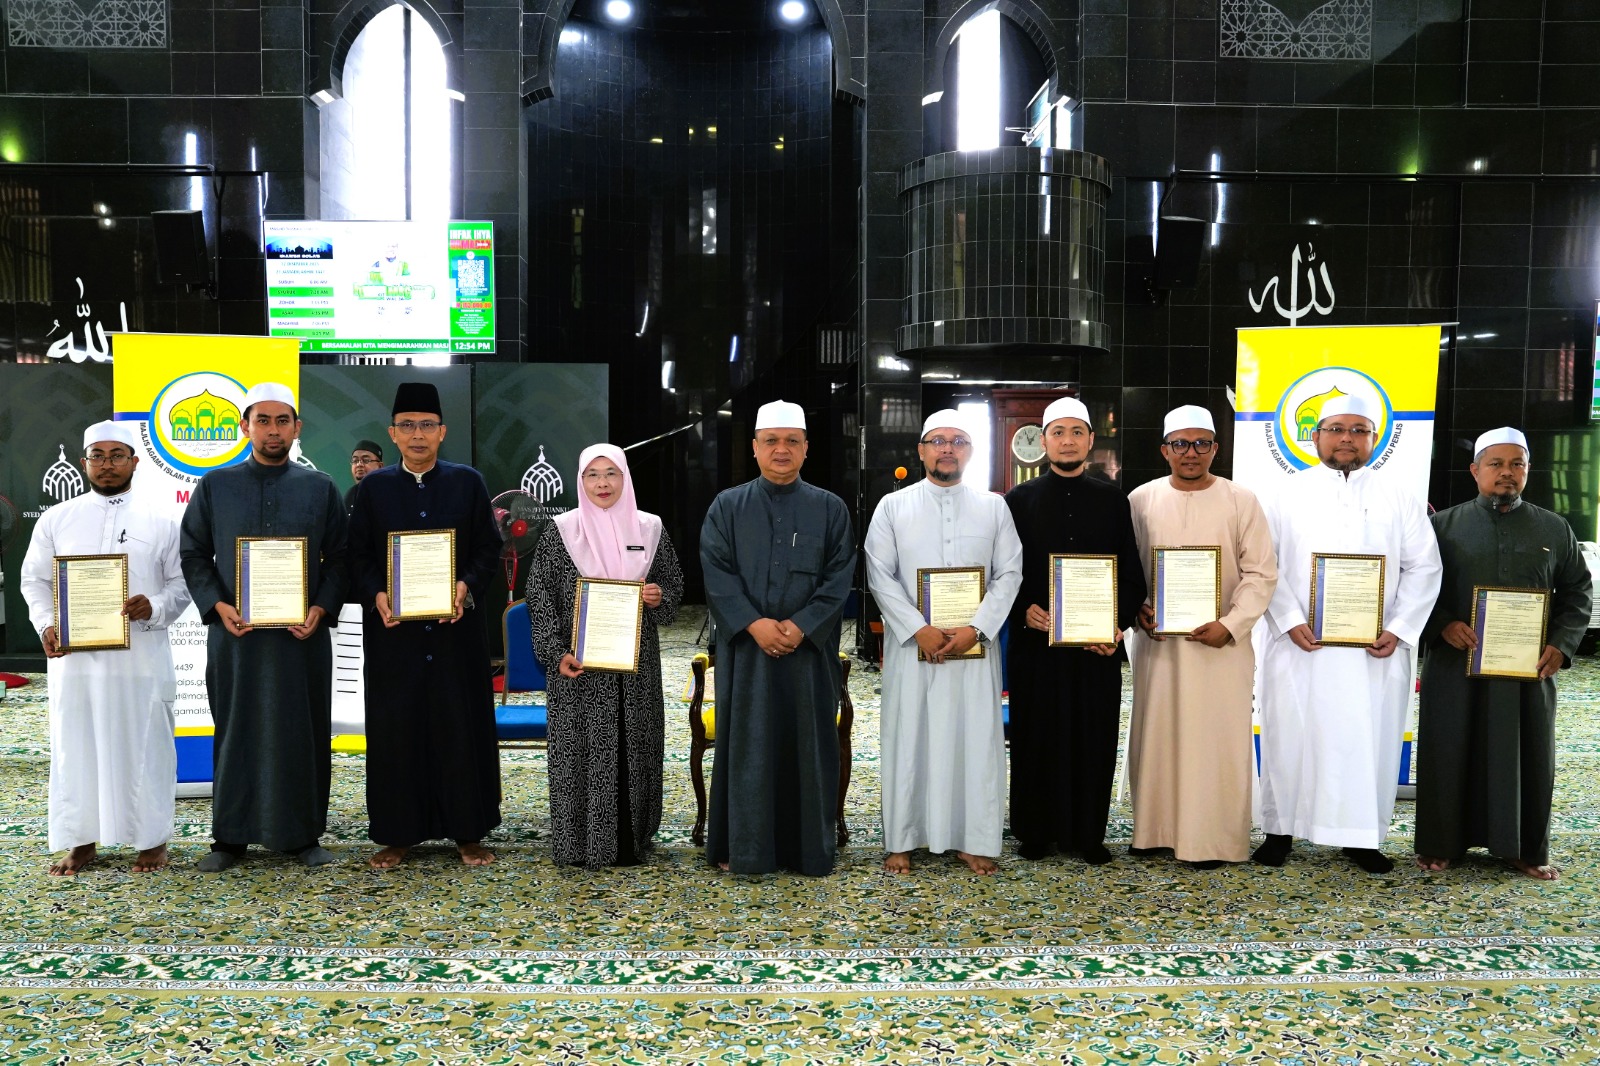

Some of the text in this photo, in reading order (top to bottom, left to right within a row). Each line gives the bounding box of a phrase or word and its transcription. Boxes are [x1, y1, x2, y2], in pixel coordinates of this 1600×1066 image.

[454, 342, 491, 350] 12:54 PM
[140, 422, 150, 447] MAJLIS
[146, 447, 165, 469] AGAMA
[163, 466, 185, 481] ISLAM
[1265, 422, 1275, 448] MAJLIS
[1270, 448, 1289, 471] AGAMA
[1371, 422, 1404, 471] MELAYU PERLIS
[176, 629, 207, 637] Tuanku
